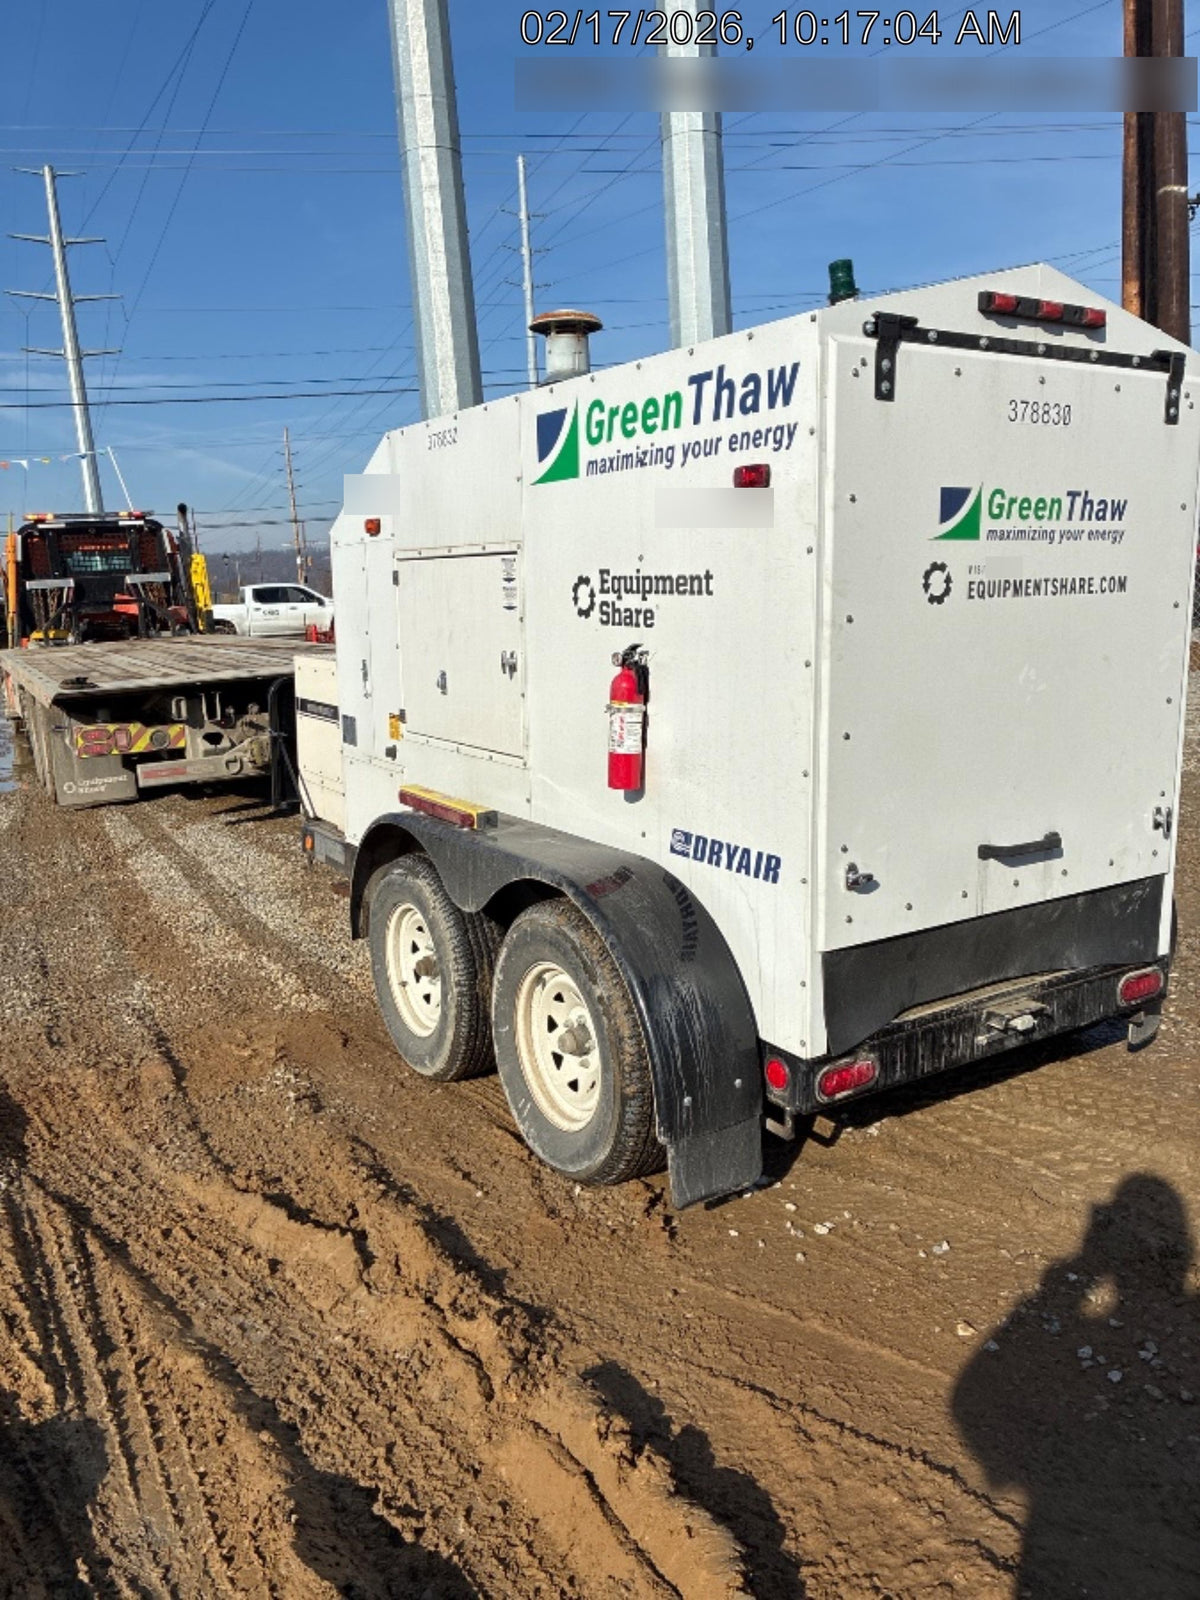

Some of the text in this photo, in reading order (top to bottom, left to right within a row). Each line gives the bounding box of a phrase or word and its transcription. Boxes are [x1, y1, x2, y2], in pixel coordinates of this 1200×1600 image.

[1008, 399, 1072, 426] 378830
[586, 421, 800, 477] maximizing your energy
[986, 526, 1126, 545] maximizing your energy
[598, 568, 714, 601] Equipment
[968, 575, 1127, 600] EQUIPMENTSHARE.COM
[598, 600, 655, 628] Share
[692, 834, 782, 884] DRYAIR
